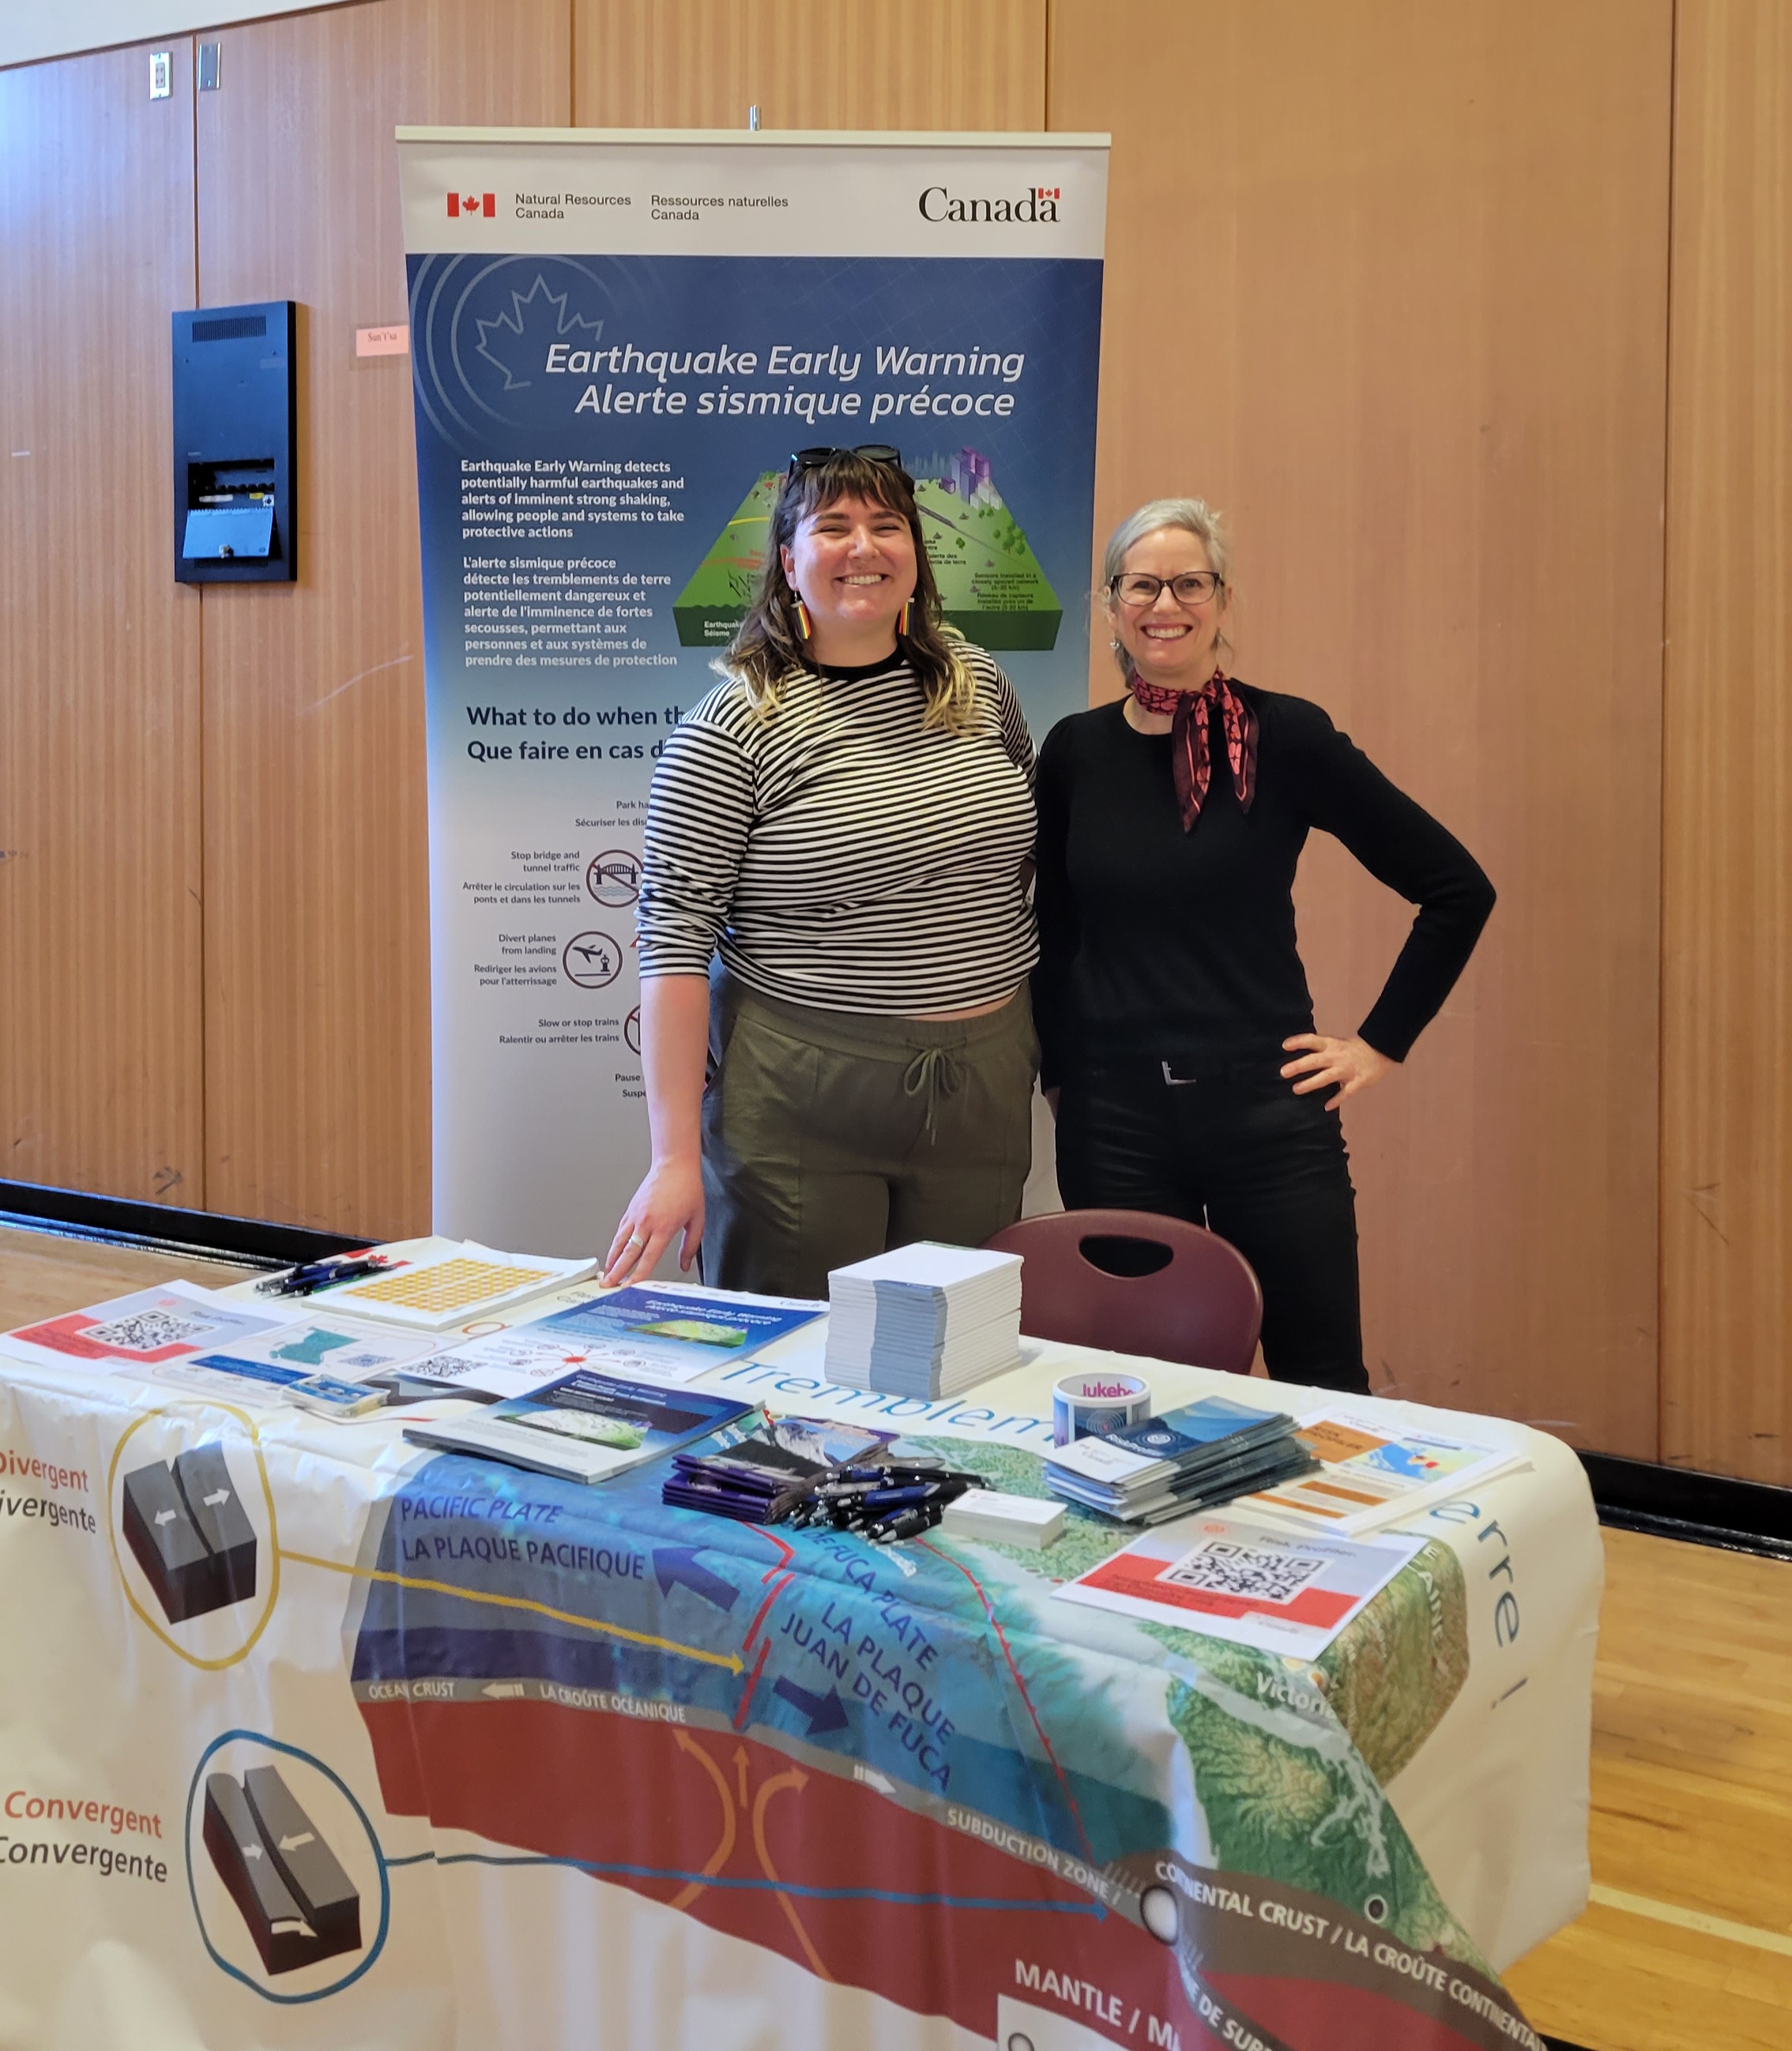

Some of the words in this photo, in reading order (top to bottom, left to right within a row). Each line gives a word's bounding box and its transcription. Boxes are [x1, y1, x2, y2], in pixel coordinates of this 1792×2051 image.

[516, 194, 560, 205] Natural
[566, 194, 631, 205] Resources
[652, 195, 724, 207] Ressources
[728, 196, 788, 207] naturelles
[918, 186, 1061, 224] Canada
[516, 208, 564, 218] Canada
[651, 209, 699, 220] Canada
[546, 344, 757, 383] Earthquake
[768, 345, 861, 382] Early
[877, 346, 1024, 382] Warning
[574, 384, 687, 414] Alerte
[697, 386, 861, 423] sismique
[870, 385, 1015, 423] précoce
[461, 459, 532, 475] Earthquake
[534, 459, 567, 475] Early
[567, 460, 622, 475] Warning
[623, 460, 671, 473] detects
[461, 476, 528, 491] potentially
[529, 476, 579, 489] harmful
[581, 476, 659, 491] earthquakes
[661, 476, 684, 489] and
[461, 492, 496, 506] alerts
[498, 492, 513, 505] of
[514, 492, 574, 506] imminent
[576, 494, 617, 507] strong
[619, 492, 671, 507] shaking,
[461, 508, 514, 524] allowing
[516, 508, 559, 524] people
[561, 509, 585, 522] and
[587, 510, 638, 524] systems
[640, 510, 654, 522] to
[657, 509, 685, 522] take
[462, 525, 525, 540] protective
[527, 525, 574, 538] actions
[463, 556, 507, 569] L'alerte
[509, 556, 565, 571] sismique
[567, 556, 617, 571] précoce
[463, 573, 510, 585] détecte
[512, 573, 530, 585] les
[532, 573, 620, 585] tremblements
[622, 573, 638, 585] de
[640, 574, 672, 585] terre
[464, 589, 563, 604] potentiellement
[564, 589, 631, 604] dangereux
[632, 590, 646, 601] et
[464, 605, 499, 618] alerte
[501, 605, 518, 618] de
[520, 605, 595, 618] l'imminence
[597, 605, 614, 618] de
[616, 605, 653, 618] fortes
[464, 623, 529, 635] secousses,
[530, 622, 602, 636] permettant
[604, 624, 627, 634] aux
[465, 640, 528, 652] personnes
[529, 638, 544, 650] et
[545, 640, 569, 650] aux
[571, 638, 629, 652] systèmes
[631, 638, 647, 650] de
[465, 653, 513, 668] prendre
[514, 653, 537, 667] des
[540, 657, 592, 666] mesures
[594, 653, 611, 666] de
[612, 653, 678, 668] protection
[466, 706, 527, 725] What
[533, 709, 556, 725] to
[563, 706, 590, 725] do
[597, 706, 657, 724] when
[468, 741, 512, 762] Que
[519, 741, 569, 759] faire
[576, 746, 602, 759] en
[609, 746, 643, 758] cas
[616, 800, 636, 810] Park
[574, 818, 616, 827] Sécuriser
[617, 817, 631, 826] les
[510, 850, 532, 861] Stop
[533, 850, 562, 861] bridge
[563, 850, 580, 860] and
[522, 863, 552, 872] tunnel
[553, 863, 580, 872] traffic
[473, 895, 498, 905] ponts
[510, 895, 532, 904] dans
[533, 894, 546, 904] les
[548, 894, 581, 904] tunnels
[498, 933, 526, 943] Divert
[528, 933, 557, 944] planes
[501, 946, 523, 955] from
[524, 945, 557, 956] landing
[473, 964, 513, 975] Rediriger
[514, 964, 527, 973] les
[528, 964, 557, 973] avions
[479, 978, 500, 987] pour
[501, 977, 558, 987] l'atterrissage
[538, 1018, 560, 1028] Slow
[573, 1018, 593, 1028] stop
[594, 1018, 619, 1026] trains
[499, 1035, 533, 1044] Ralentir
[548, 1034, 579, 1044] arrêter
[580, 1033, 593, 1043] les
[594, 1033, 620, 1042] trains
[615, 1073, 641, 1082] Pause
[401, 1497, 484, 1520] PACIFIC
[488, 1501, 563, 1524] PLATE
[402, 1538, 431, 1561] LA
[435, 1537, 520, 1564] PLAQUE
[527, 1541, 645, 1580] PACIFIQUE
[824, 1544, 877, 1594] FUCA
[872, 1590, 939, 1671] PLATE
[822, 1601, 853, 1646] LA
[857, 1635, 955, 1744] PLAQUE
[412, 1681, 454, 1698] CRUST
[781, 1613, 849, 1680] JUAN
[852, 1671, 888, 1716] DE
[888, 1709, 951, 1792] FUCA
[5, 1790, 162, 1838] Convergent
[948, 1808, 1060, 1870] SUBDUCTION
[1063, 1860, 1109, 1898] ZONE
[1259, 1901, 1330, 1940] CRUST
[1345, 1928, 1368, 1958] LA
[1374, 1941, 1446, 1992] CROÛTE
[1015, 1959, 1123, 2027] MANTLE
[1128, 2008, 1140, 2034] /
[1199, 1993, 1224, 2027] DE
